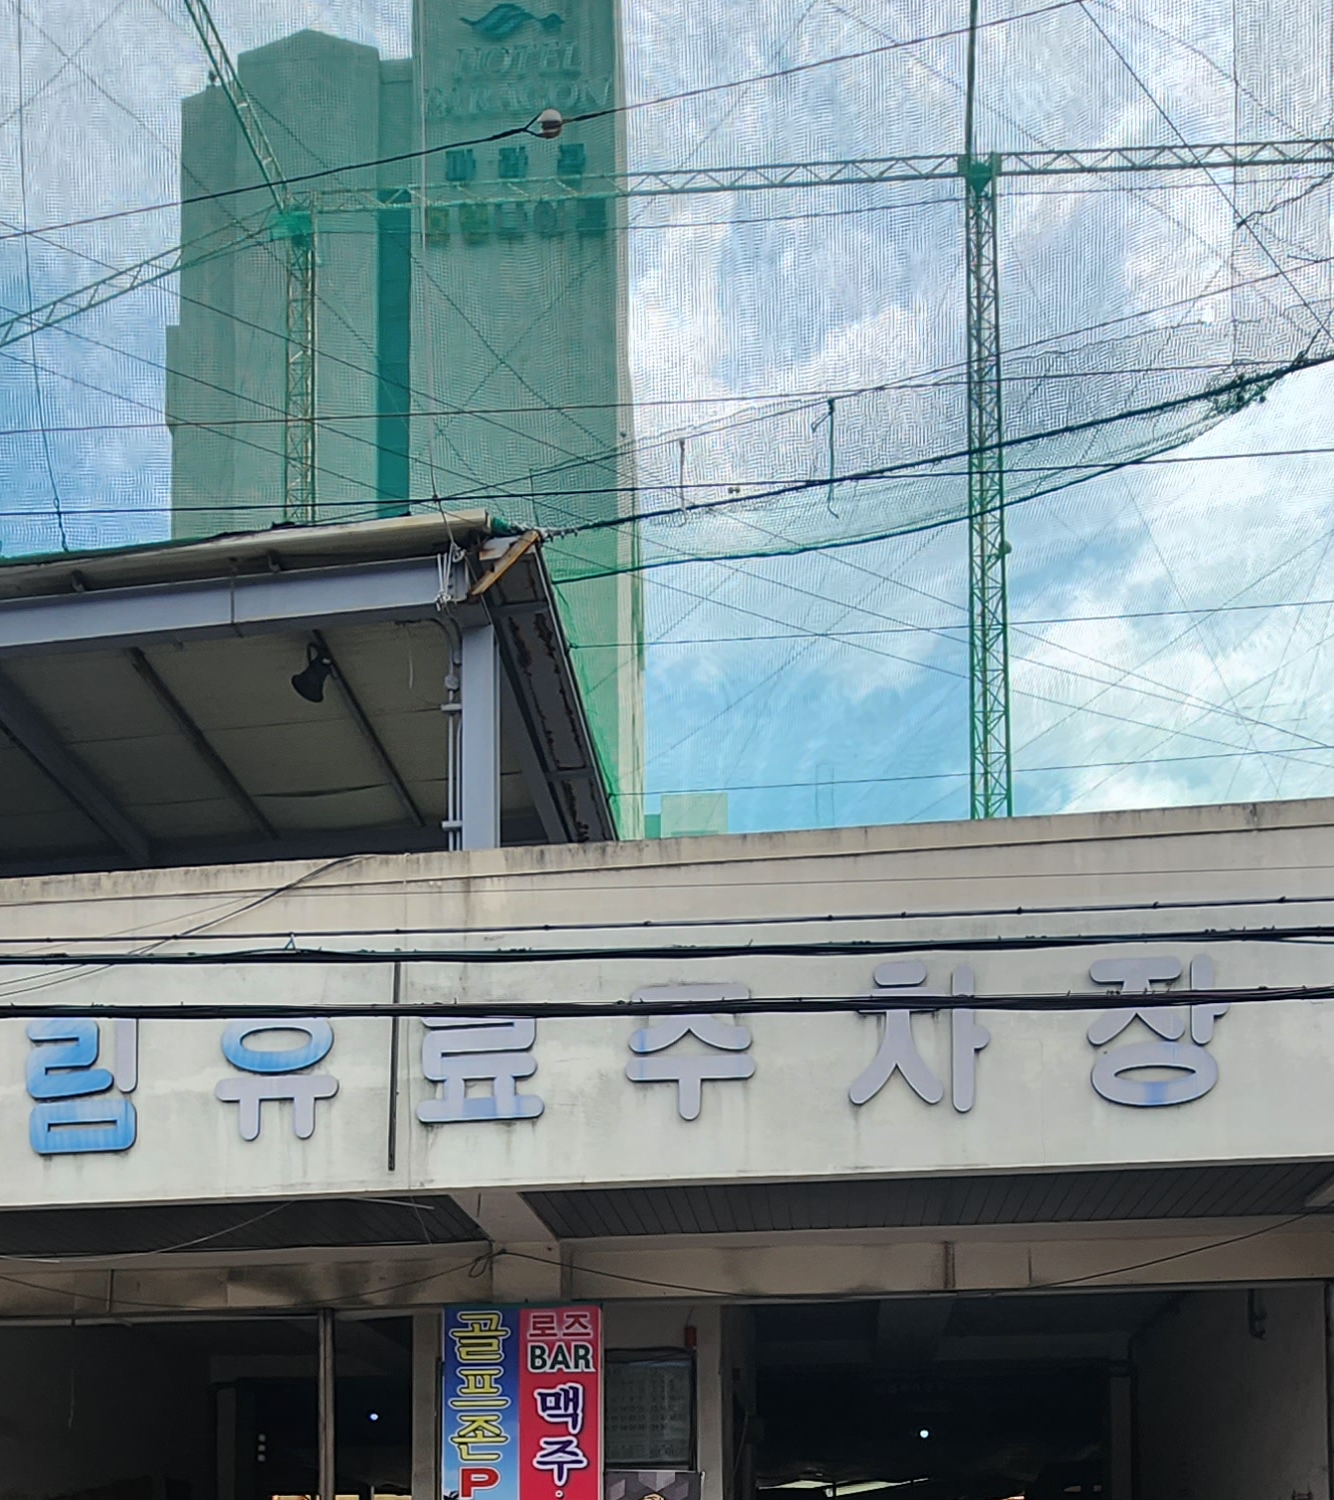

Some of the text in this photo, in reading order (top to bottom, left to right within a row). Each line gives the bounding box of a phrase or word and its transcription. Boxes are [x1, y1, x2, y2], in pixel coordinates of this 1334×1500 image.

[527, 1311, 593, 1339] 로즈
[527, 1341, 596, 1372] BAR
[449, 1311, 511, 1463] 골프존
